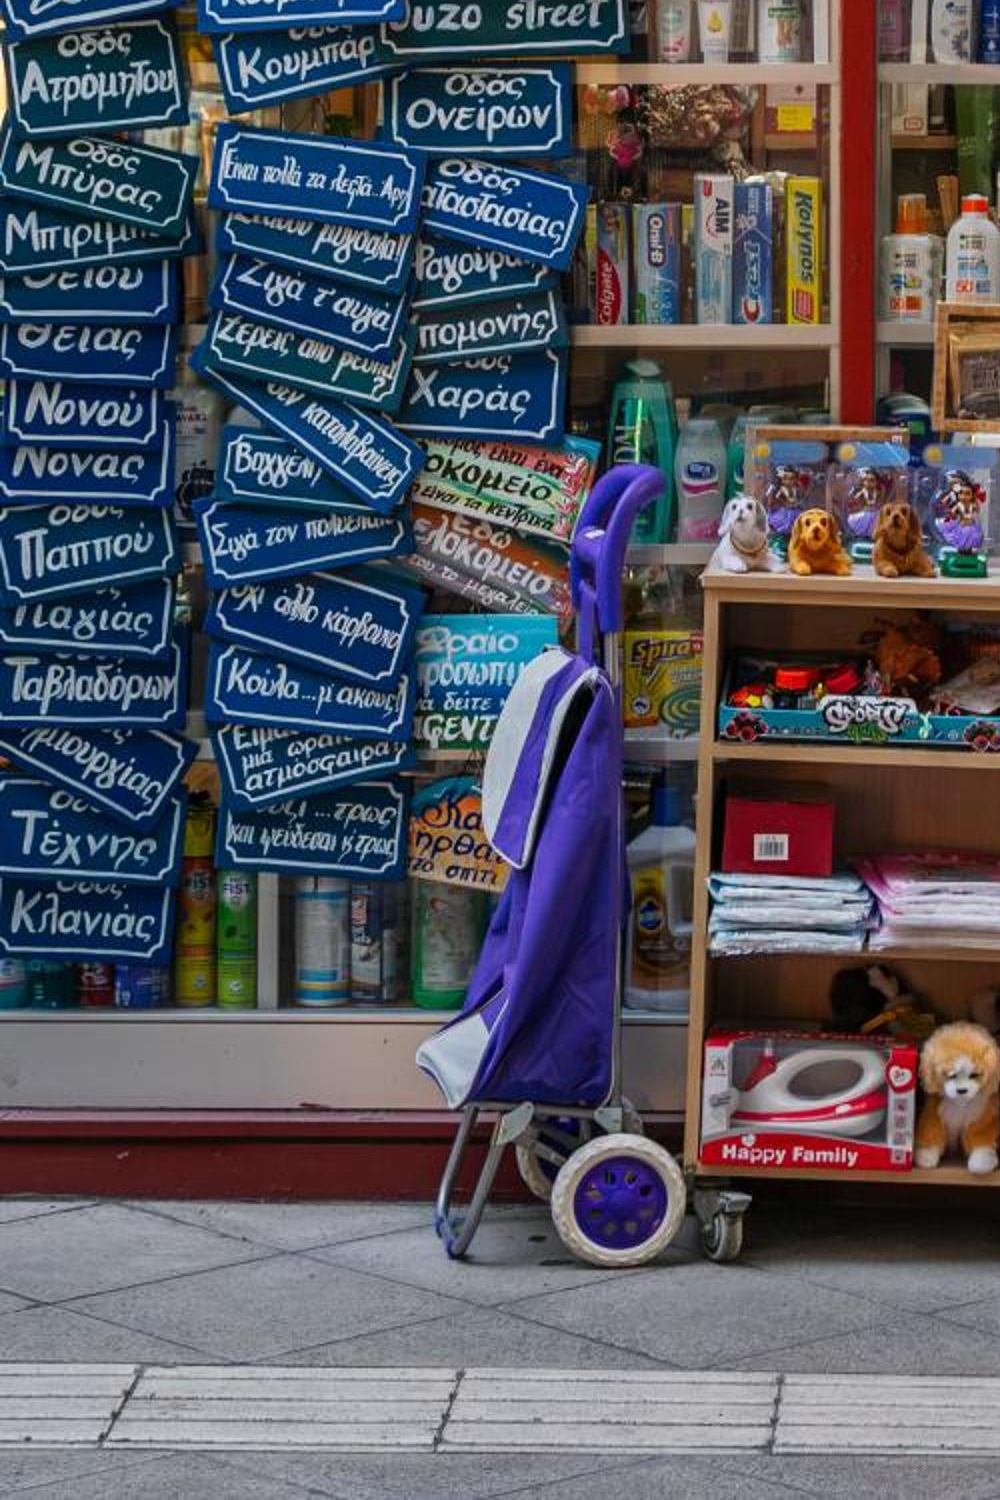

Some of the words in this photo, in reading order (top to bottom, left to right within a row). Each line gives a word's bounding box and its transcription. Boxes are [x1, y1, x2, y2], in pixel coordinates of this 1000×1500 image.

[237, 35, 376, 90] Κουμπάρ
[405, 98, 553, 144] Ονείρων
[15, 141, 163, 213] Μπύρας
[714, 197, 731, 234] AIM
[410, 301, 550, 351] πομονής
[24, 380, 144, 428] Νονού
[409, 368, 531, 424] Χαράς
[14, 520, 155, 581] Παππού
[11, 809, 158, 872] Τέχνης
[11, 888, 156, 942] Κλανιάς
[721, 1143, 786, 1164] Happy
[792, 1146, 859, 1166] Family
